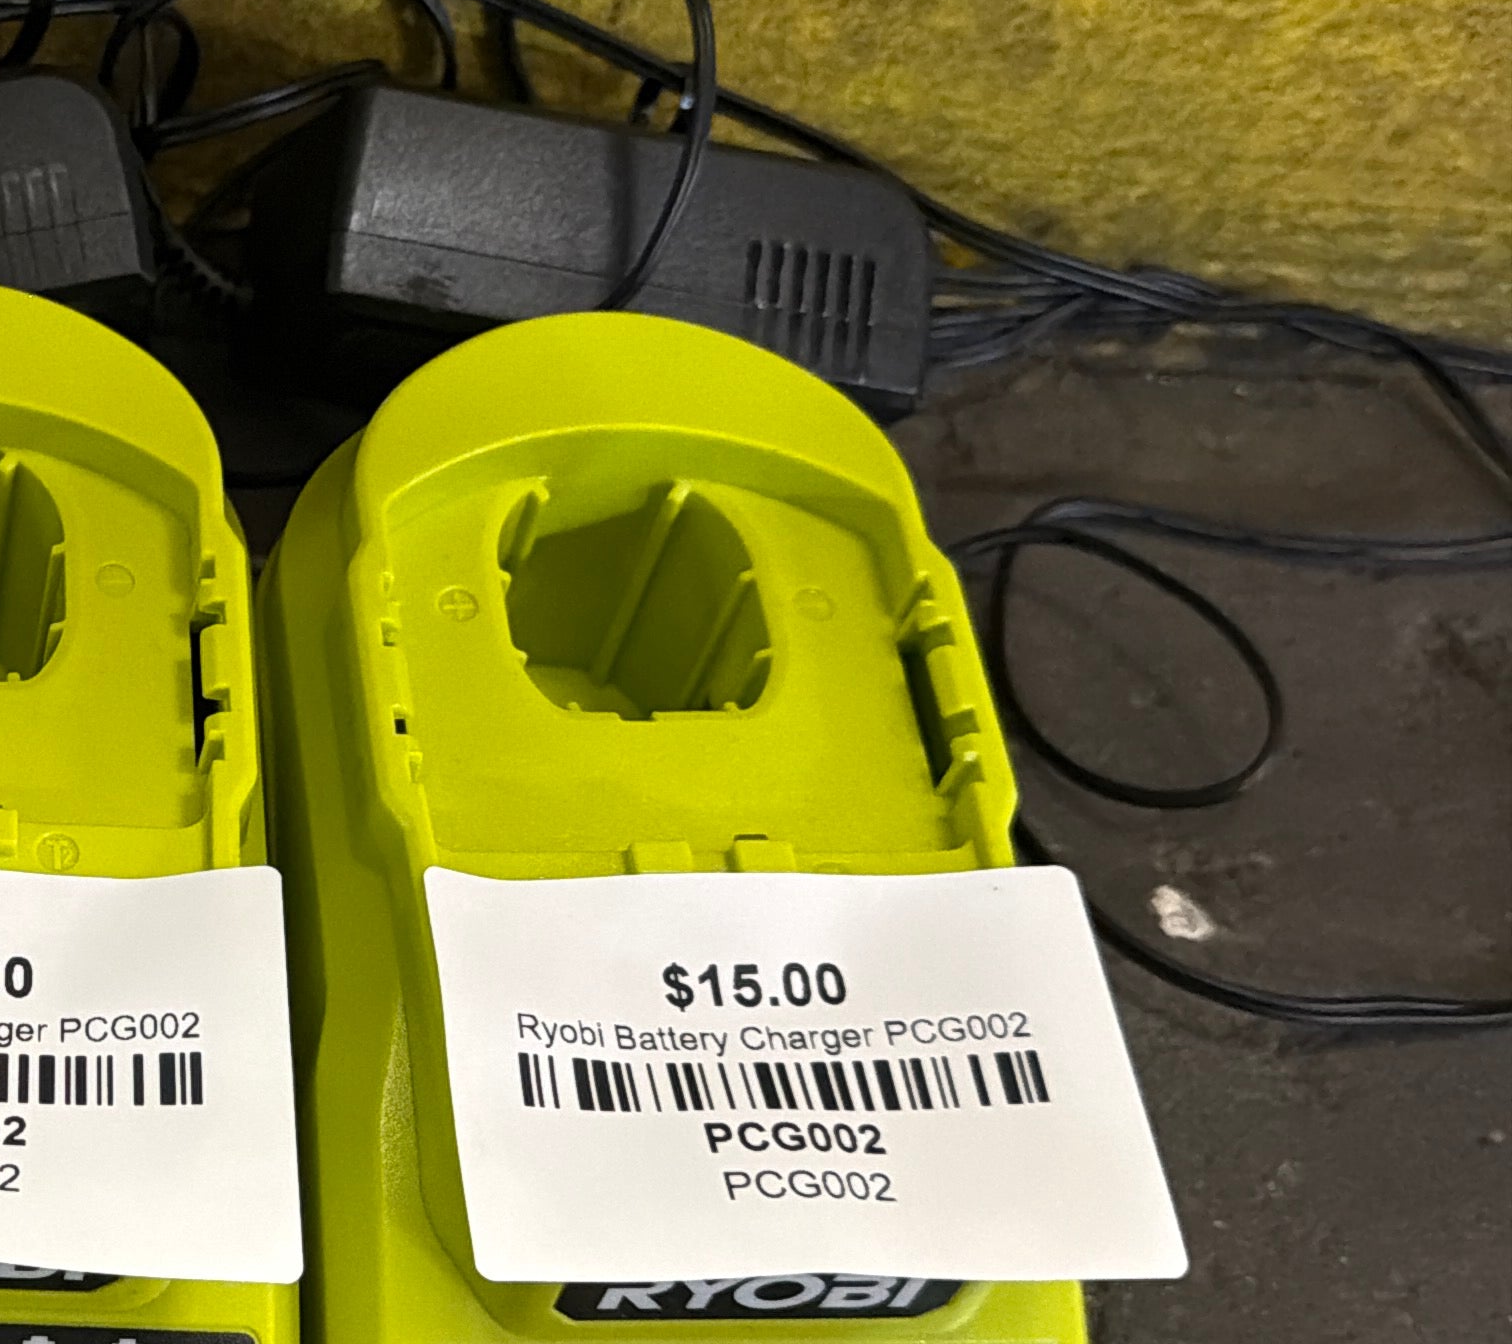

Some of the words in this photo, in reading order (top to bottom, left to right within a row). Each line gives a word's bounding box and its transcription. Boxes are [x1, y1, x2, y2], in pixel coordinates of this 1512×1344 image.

[663, 963, 846, 1012] $15.00
[61, 1013, 199, 1042] PCG002
[518, 1013, 603, 1048] Ryobi
[615, 1025, 727, 1056] Battery
[741, 1027, 871, 1055] Charger
[885, 1013, 1030, 1045] PCG002
[704, 1122, 886, 1154] PCG002
[724, 1170, 895, 1201] PCG002
[597, 1272, 925, 1310] RYOBI
